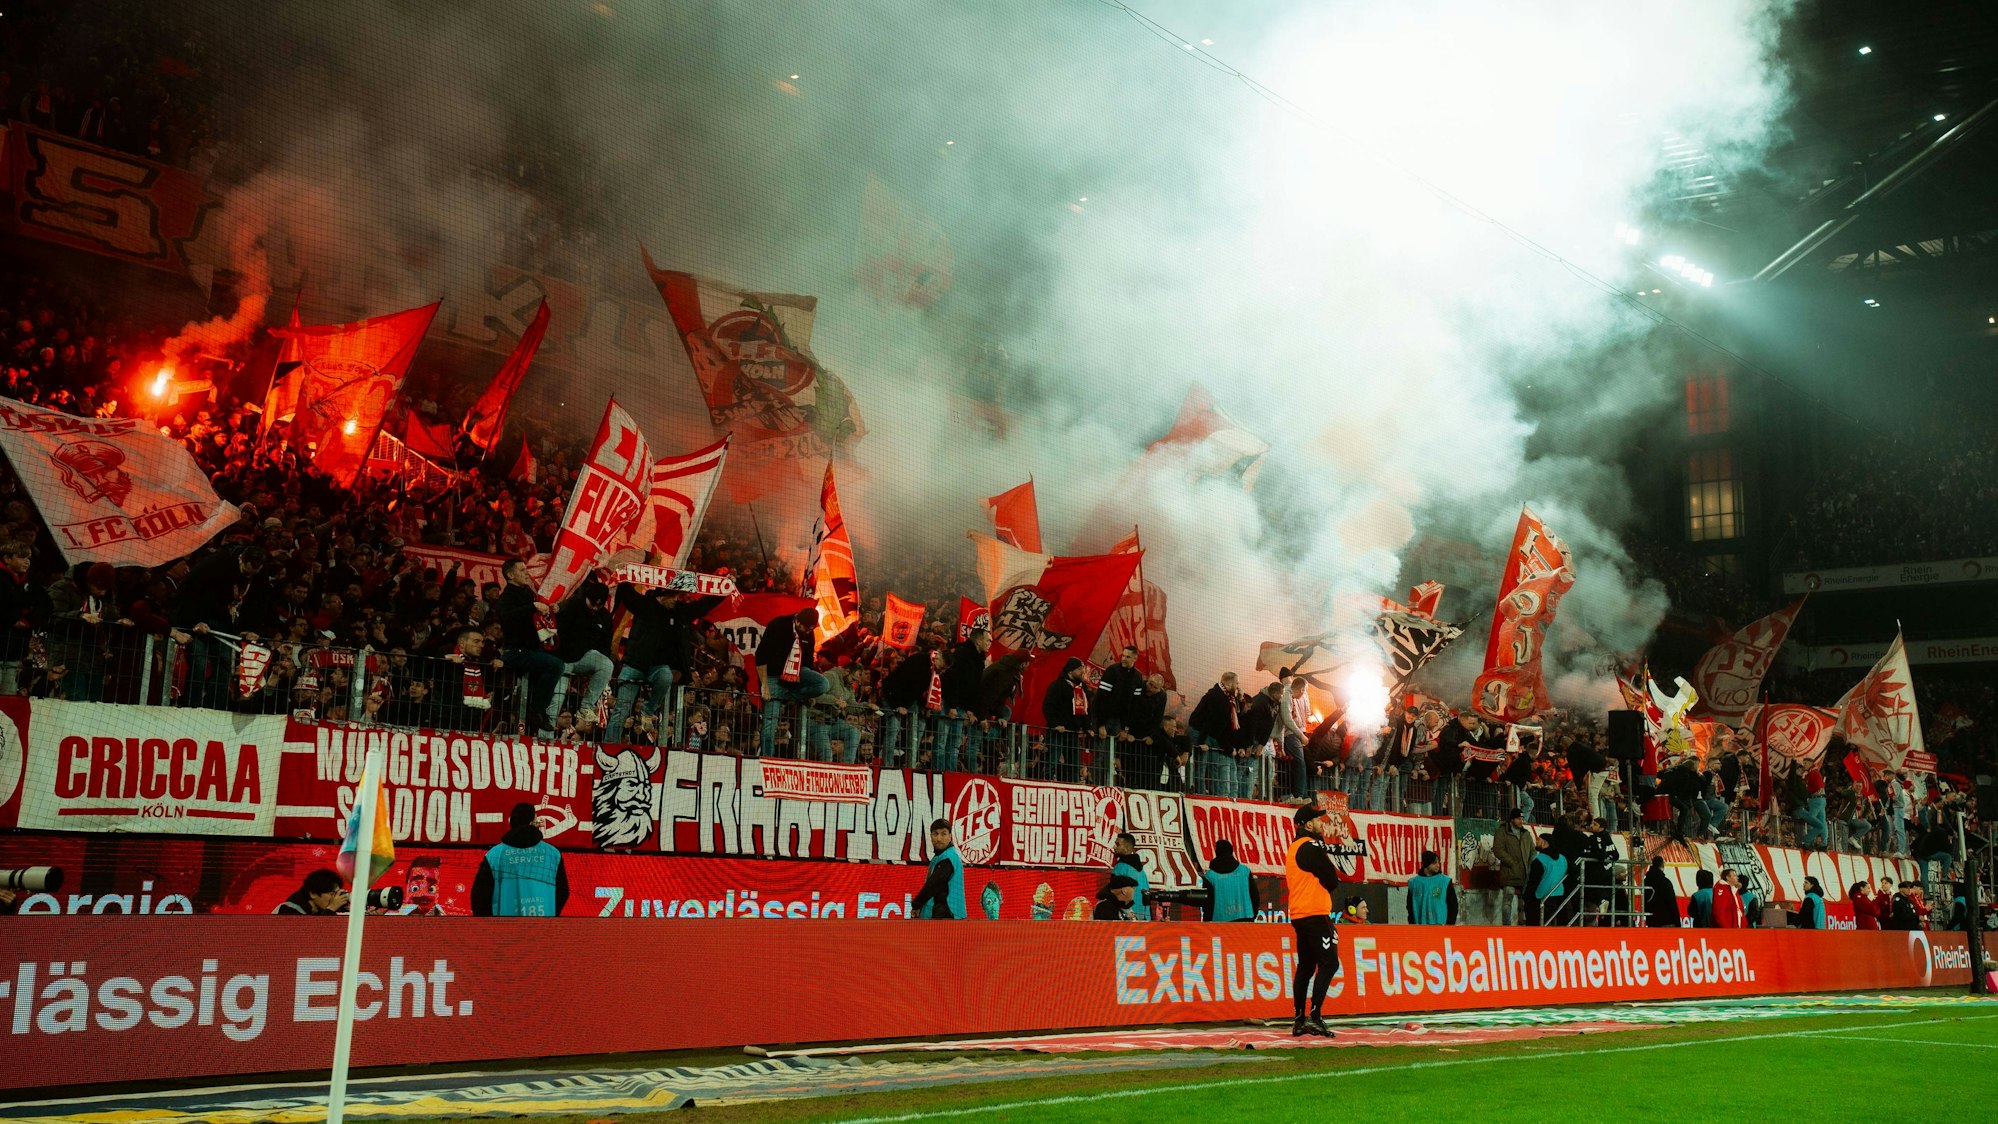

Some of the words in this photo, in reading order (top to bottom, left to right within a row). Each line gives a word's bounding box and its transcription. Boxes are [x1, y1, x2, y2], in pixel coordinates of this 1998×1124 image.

[87, 518, 127, 545] FC
[1824, 574, 1879, 585] RheinEnergie
[1900, 573, 1940, 583] Energie
[1903, 566, 1933, 574] Rhein
[54, 735, 261, 804] CRICCAA
[141, 803, 184, 818] KÖLN
[337, 785, 471, 842] SDION
[1011, 786, 1096, 827] SEMPER
[1012, 824, 1088, 864] FIDELIS
[1193, 805, 1296, 866] DOMSTAD
[1367, 823, 1452, 876] SYNDIKAT
[509, 856, 545, 864] SERVCE
[1115, 936, 1345, 1005] Exklusie
[1354, 936, 1645, 996] Fussballmomente
[1654, 938, 1755, 984] erleben.
[11, 959, 270, 1042] lässig
[293, 956, 473, 1022] Echt.
